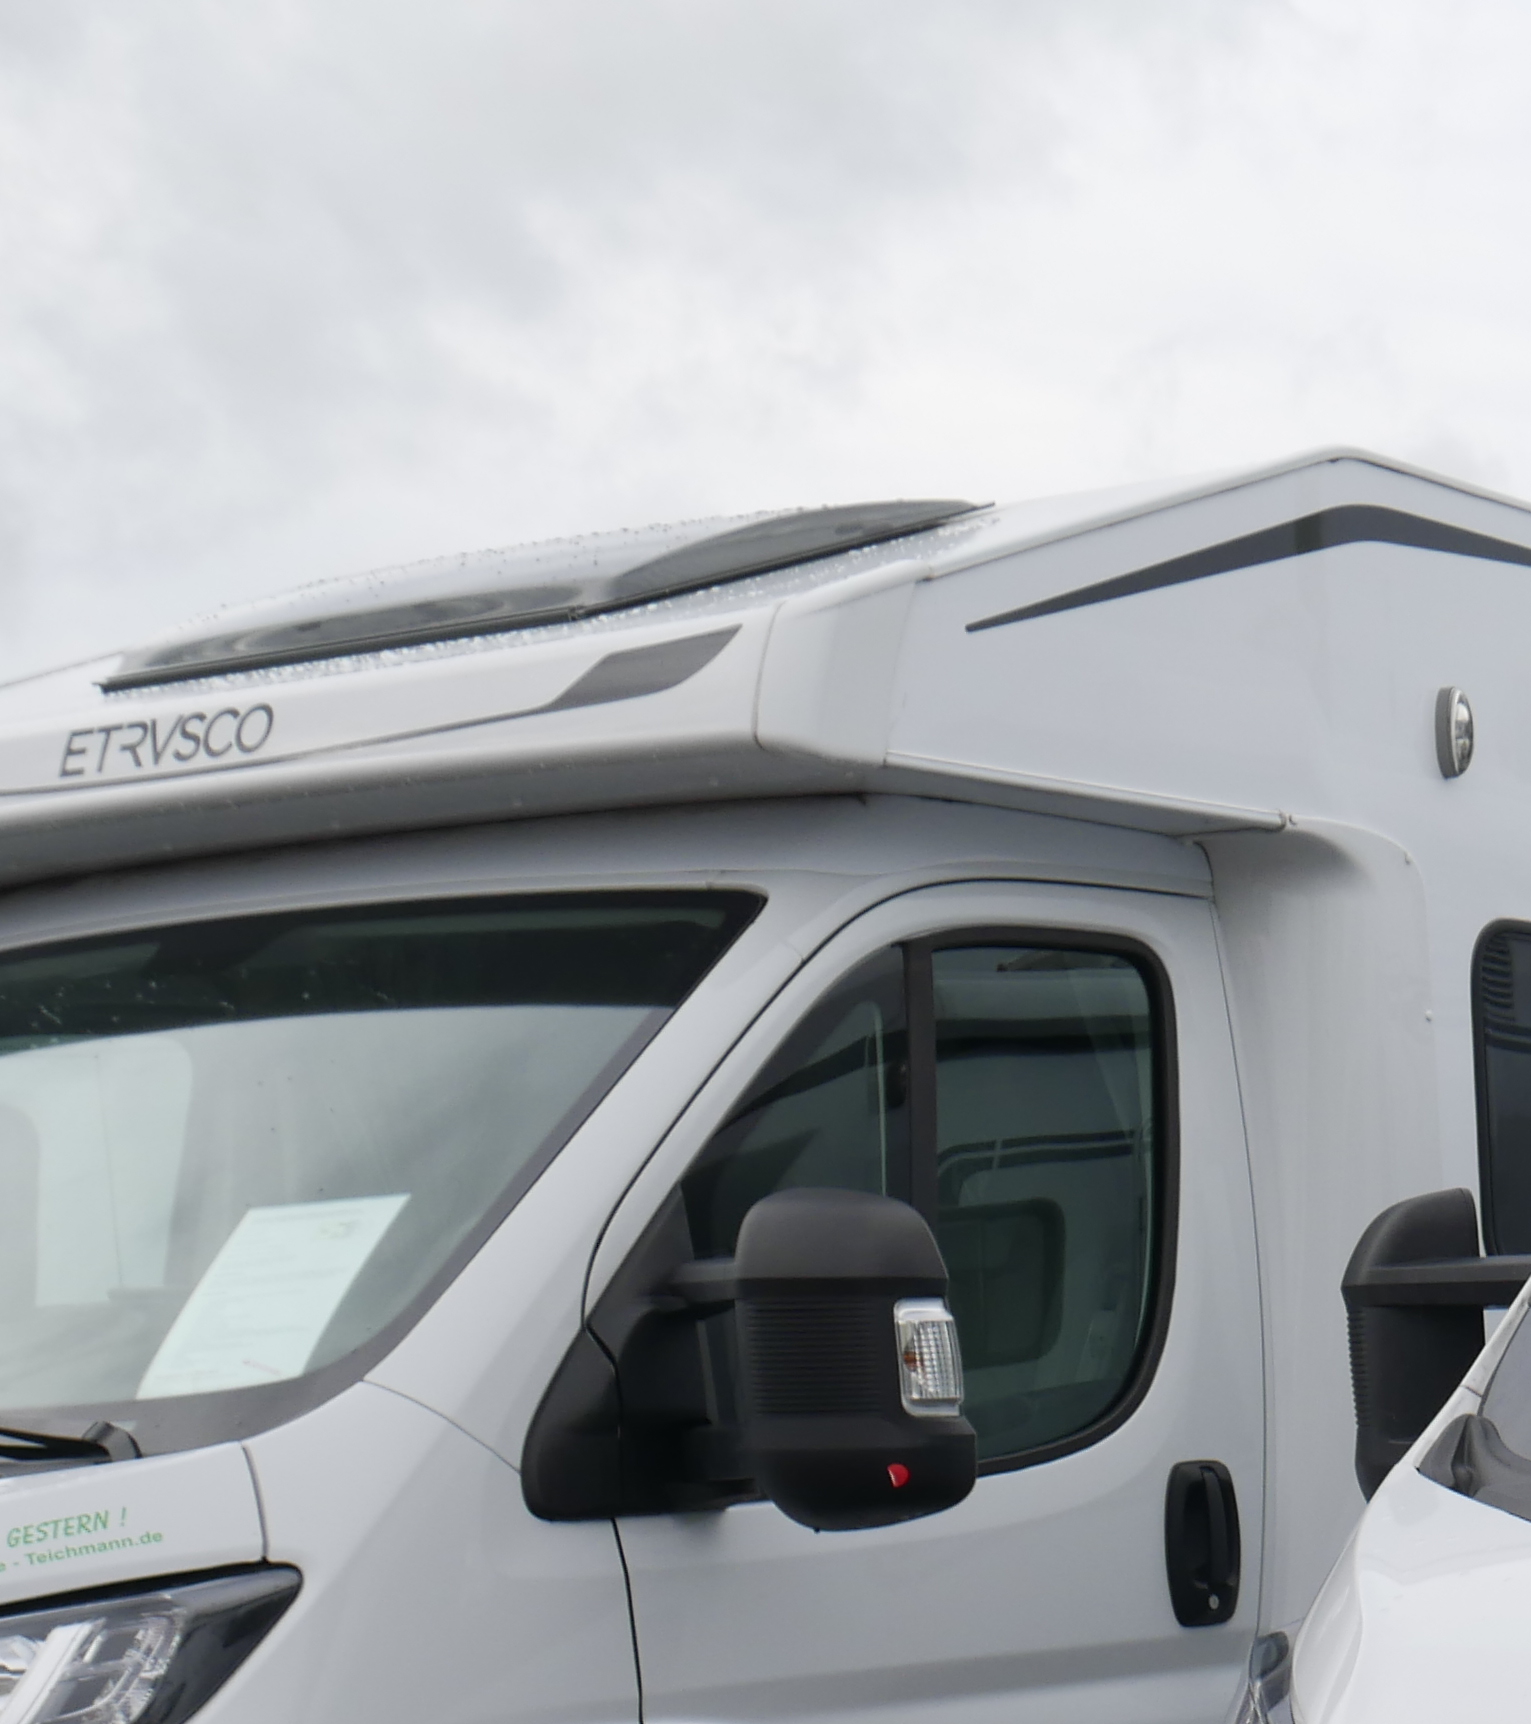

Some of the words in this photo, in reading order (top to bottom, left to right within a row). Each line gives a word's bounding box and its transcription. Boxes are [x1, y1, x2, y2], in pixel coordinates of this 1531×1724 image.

[59, 702, 275, 778] ETRVSCO
[7, 1510, 110, 1548] GESTERN
[24, 1530, 163, 1566] Teichmann.de
